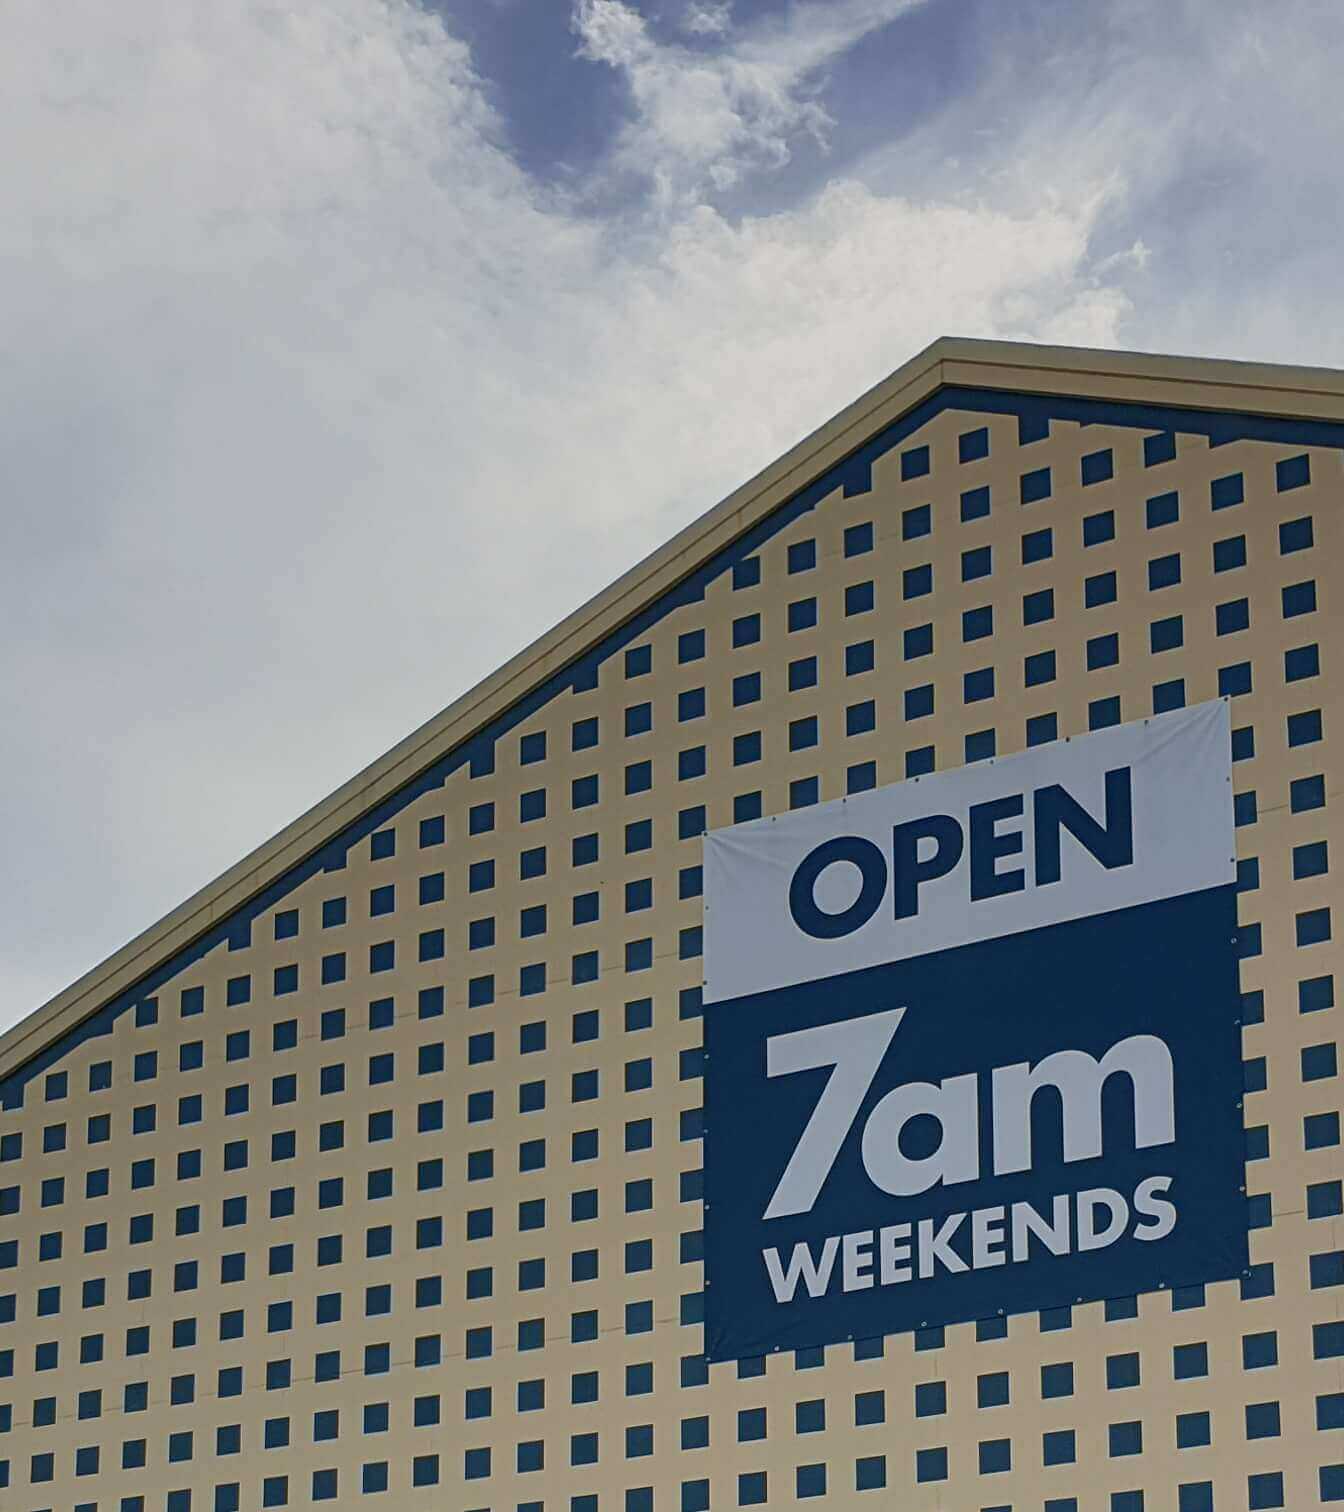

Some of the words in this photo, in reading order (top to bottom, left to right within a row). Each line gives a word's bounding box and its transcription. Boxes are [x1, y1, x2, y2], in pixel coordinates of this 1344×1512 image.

[788, 765, 1134, 940] OPEN
[761, 1006, 1176, 1220] 7am
[761, 1175, 1177, 1304] WEEKENDS
